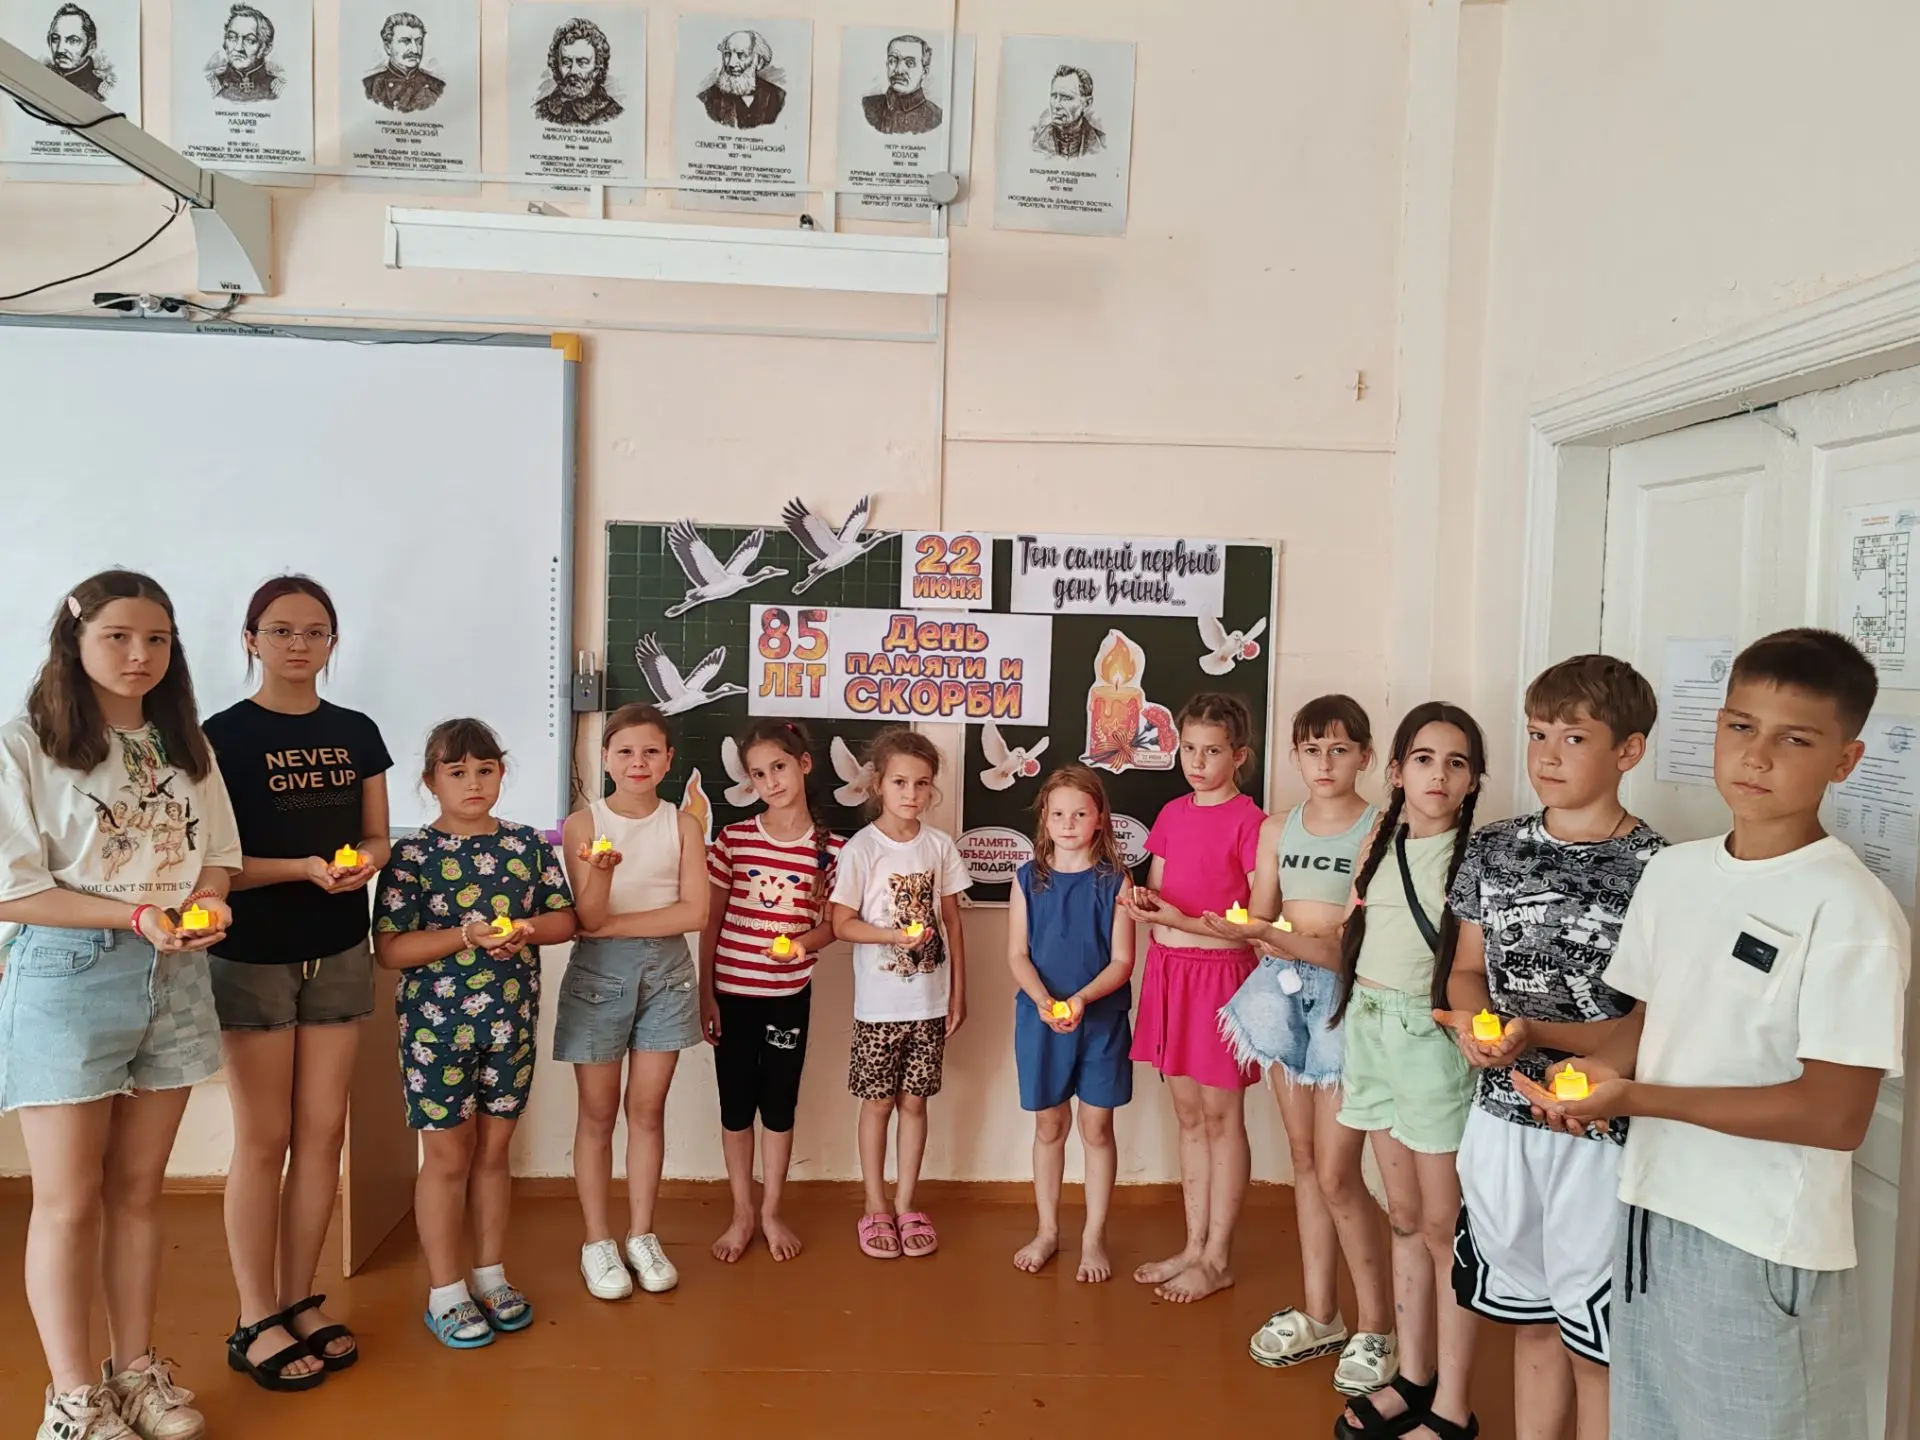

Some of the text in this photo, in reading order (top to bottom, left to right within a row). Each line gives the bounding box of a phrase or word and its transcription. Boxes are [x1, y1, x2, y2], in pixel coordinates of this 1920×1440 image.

[381, 127, 439, 137] ПРЖЕВАЛЬСКИЙ
[188, 144, 225, 152] УЧАСТВОВАЛ
[695, 140, 727, 150] СЕМЕНОВ
[892, 151, 919, 159] КОЗЛОВ
[1047, 176, 1078, 185] АРСЕНЬЕВ
[1008, 195, 1054, 203] ИССЛЕДОВАТЕЛЬ
[915, 535, 981, 576] 22
[1018, 535, 1220, 582] Тот самый первый
[913, 576, 982, 600] ИЮНЯ
[1053, 576, 1101, 609] день
[758, 607, 828, 661] 85
[882, 614, 989, 653] День
[845, 653, 987, 679] ПАМЯТИ
[759, 662, 826, 698] ЛЕТ
[844, 676, 1023, 718] СКОРБИ
[265, 747, 352, 770] NEVER
[269, 769, 356, 792] GIVE UP
[969, 837, 1018, 848] ПАМЯТЬ
[968, 861, 1017, 873] ЛЮДЕЙ!
[1282, 854, 1352, 874] NICE
[80, 881, 192, 893] YOU CAN'T SIT WITH US
